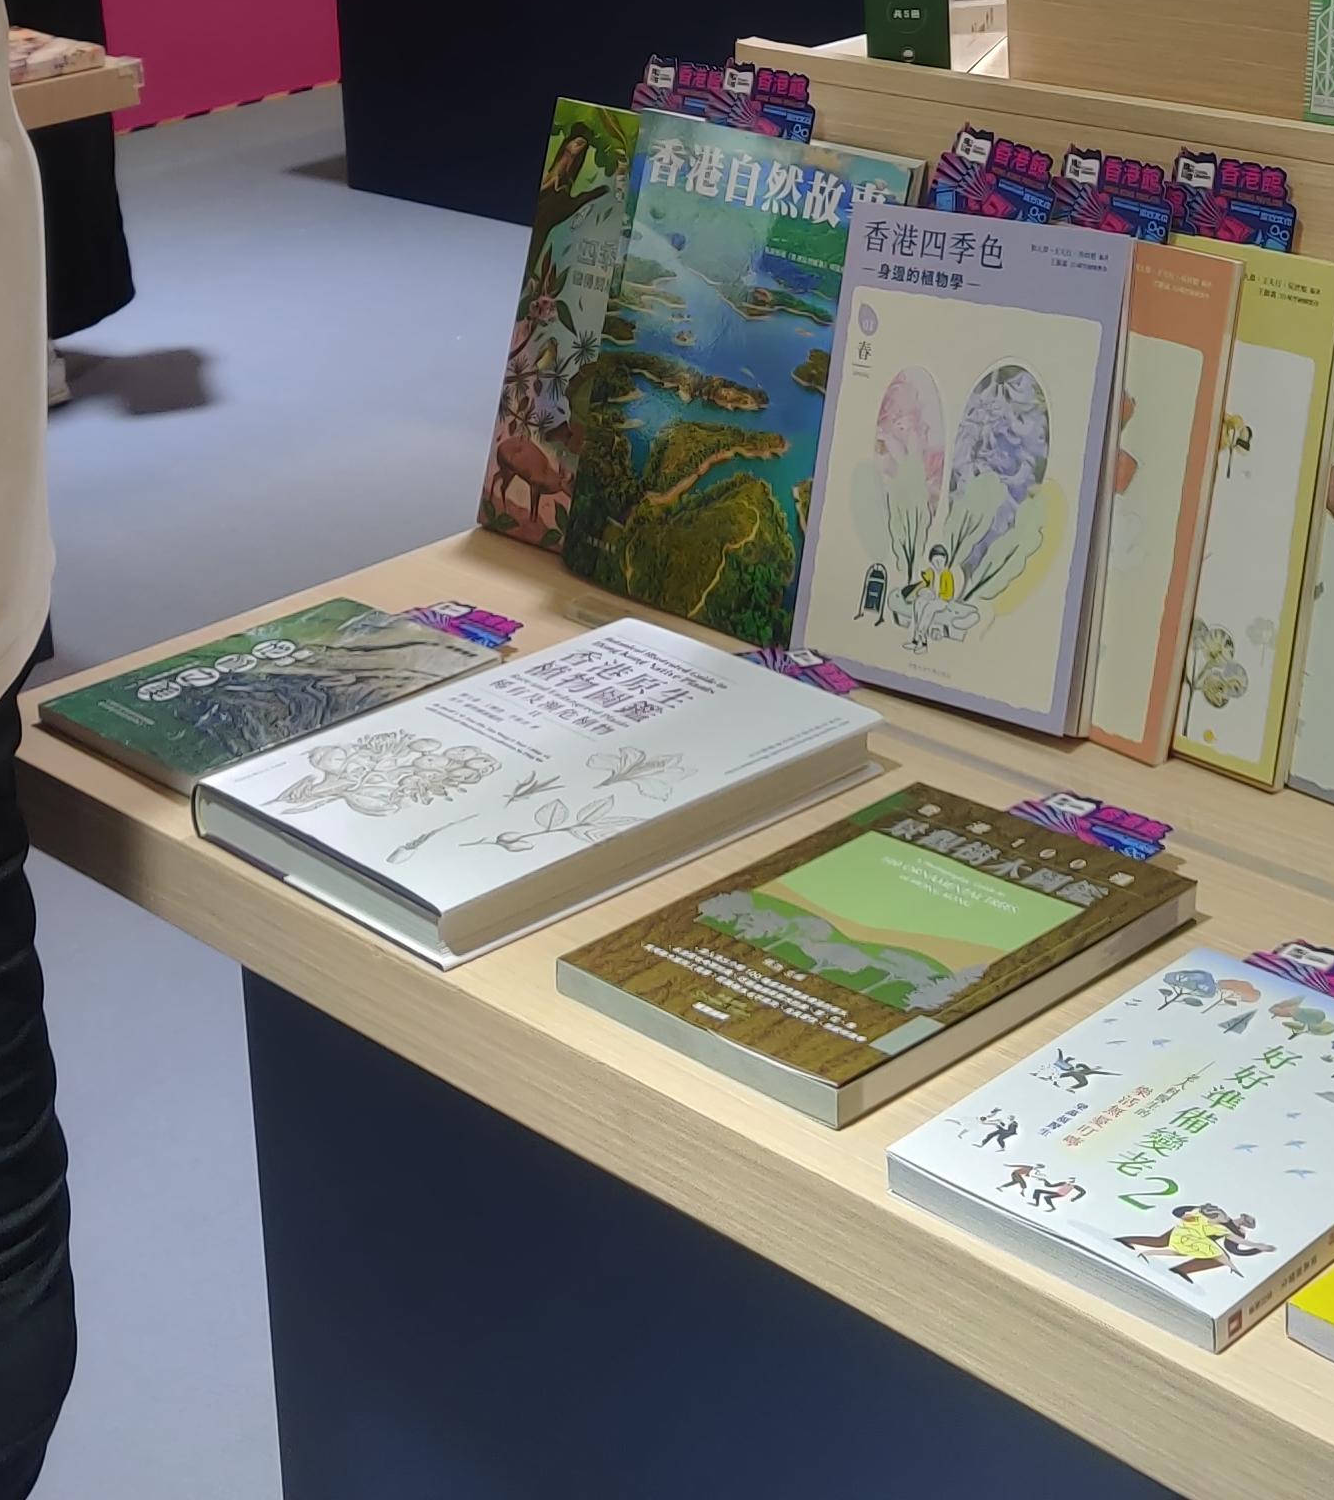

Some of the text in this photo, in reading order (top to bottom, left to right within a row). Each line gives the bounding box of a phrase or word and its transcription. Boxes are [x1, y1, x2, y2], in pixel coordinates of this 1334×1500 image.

[993, 140, 1049, 177] 香港館
[1103, 157, 1163, 191] 香港館
[1219, 161, 1284, 194] 香港館
[864, 220, 1004, 270] 香港四季色
[857, 340, 872, 361] 春
[519, 659, 670, 723] 植物圖鑑
[553, 646, 704, 710] 香港原生
[1102, 1041, 1309, 1214] 好好準備變老 2
